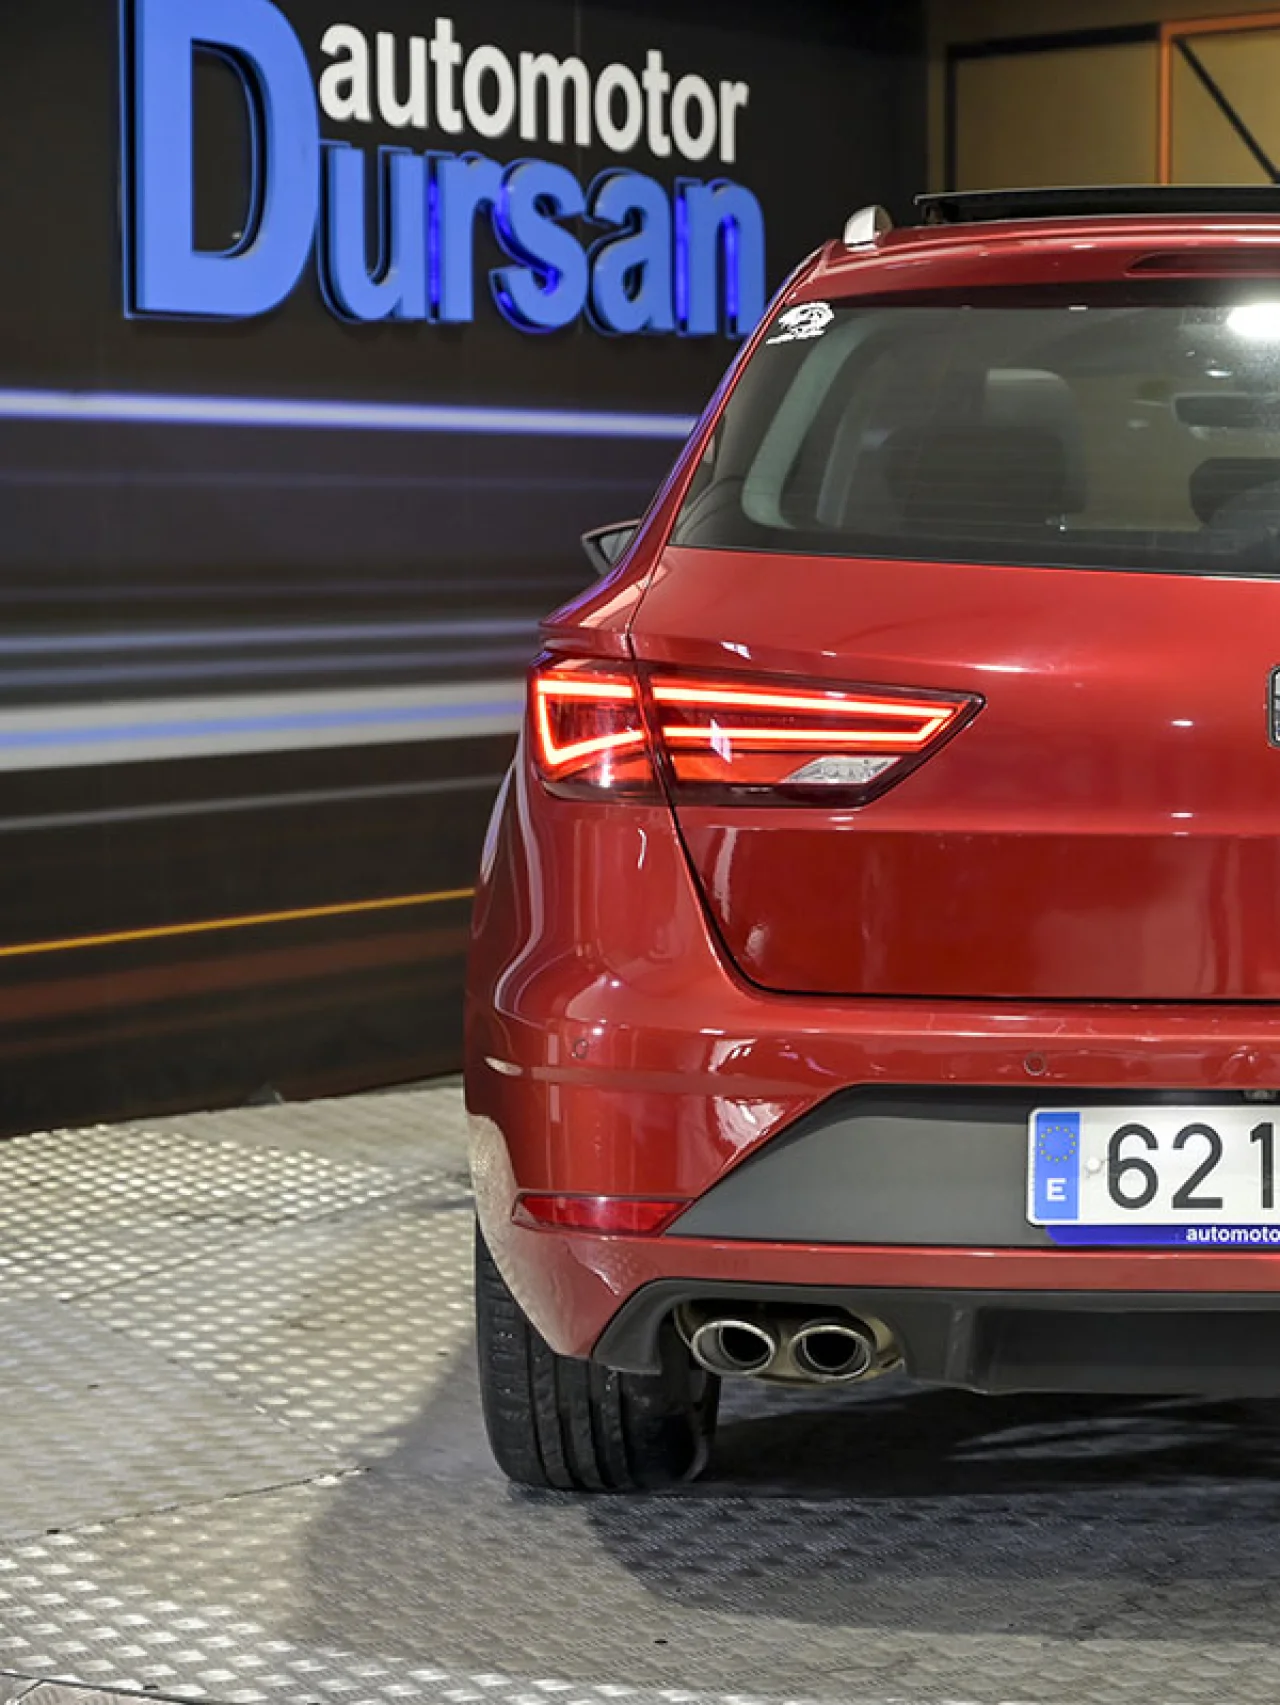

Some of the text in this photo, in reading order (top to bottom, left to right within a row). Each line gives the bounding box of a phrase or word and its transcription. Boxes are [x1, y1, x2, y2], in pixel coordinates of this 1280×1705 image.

[318, 18, 749, 163] automotor
[121, 0, 767, 338] Dursan
[1046, 1178, 1067, 1202] E
